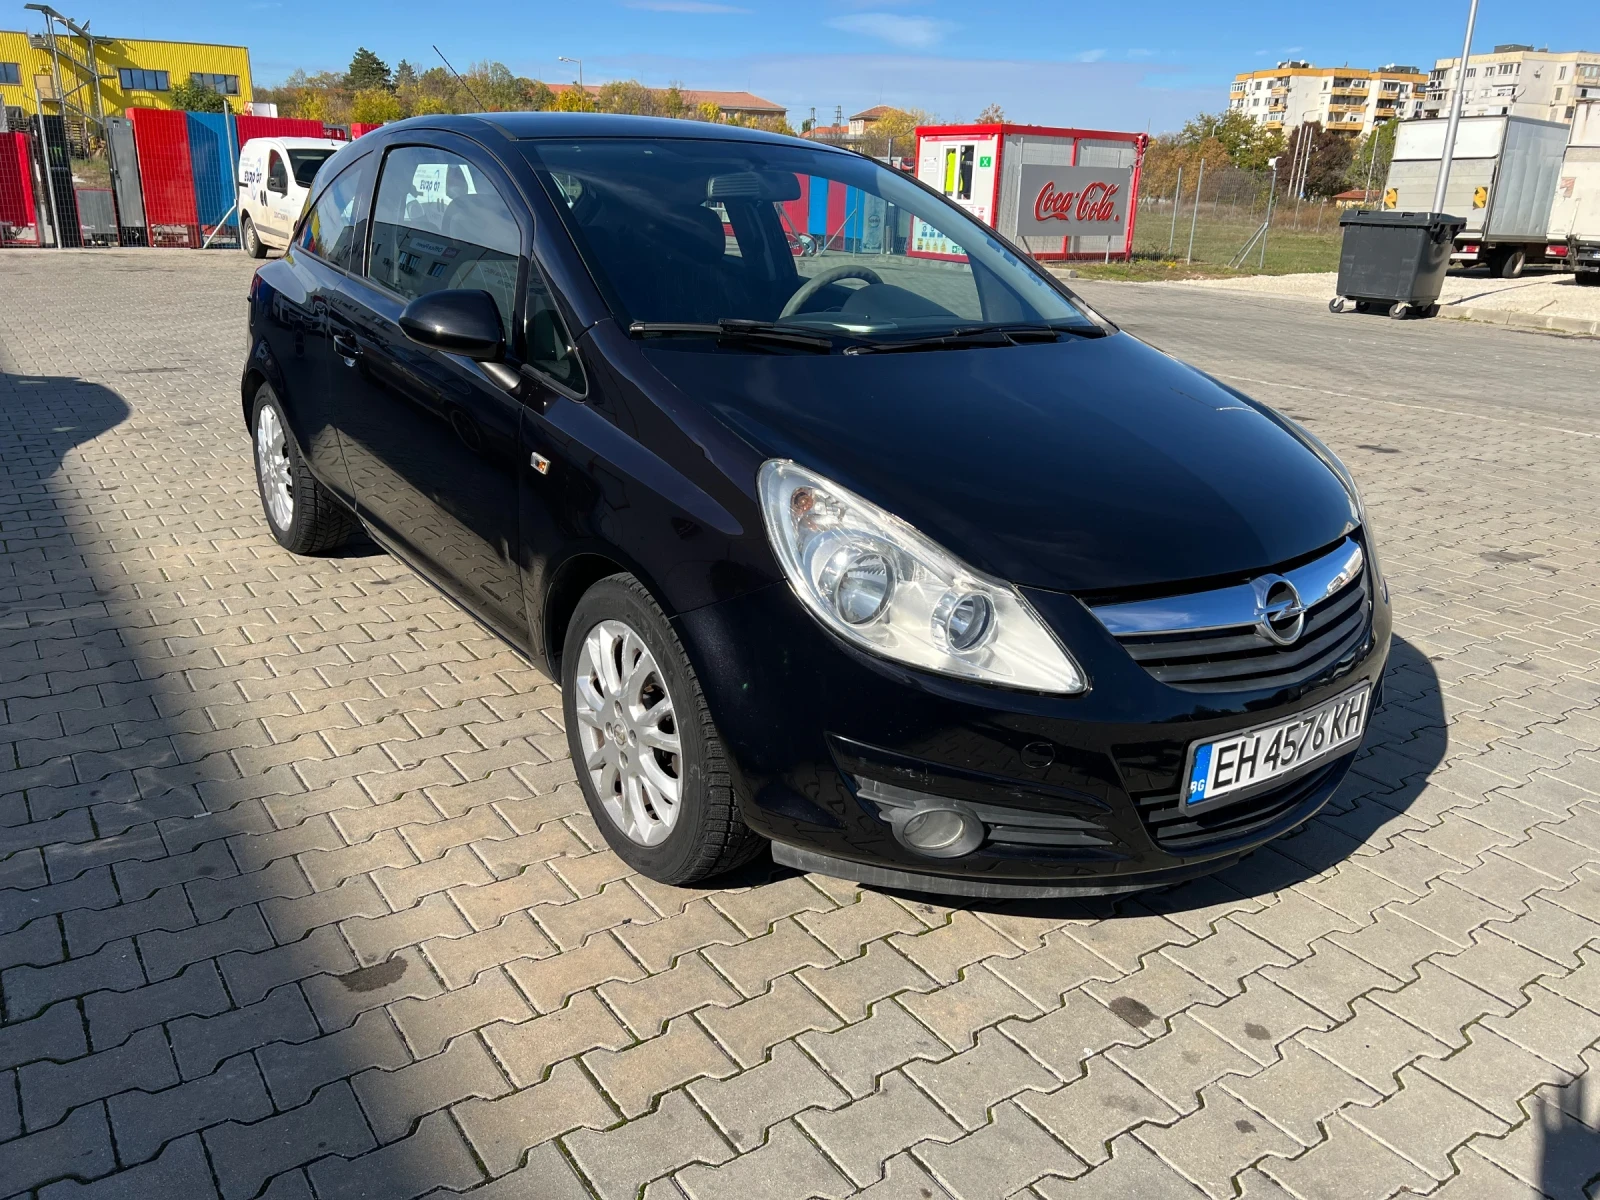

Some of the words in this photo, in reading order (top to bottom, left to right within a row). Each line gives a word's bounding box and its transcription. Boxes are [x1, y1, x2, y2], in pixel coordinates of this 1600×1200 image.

[1034, 181, 1119, 221] Coca-Cola
[1264, 712, 1327, 771] 4576
[1190, 779, 1206, 794] BG
